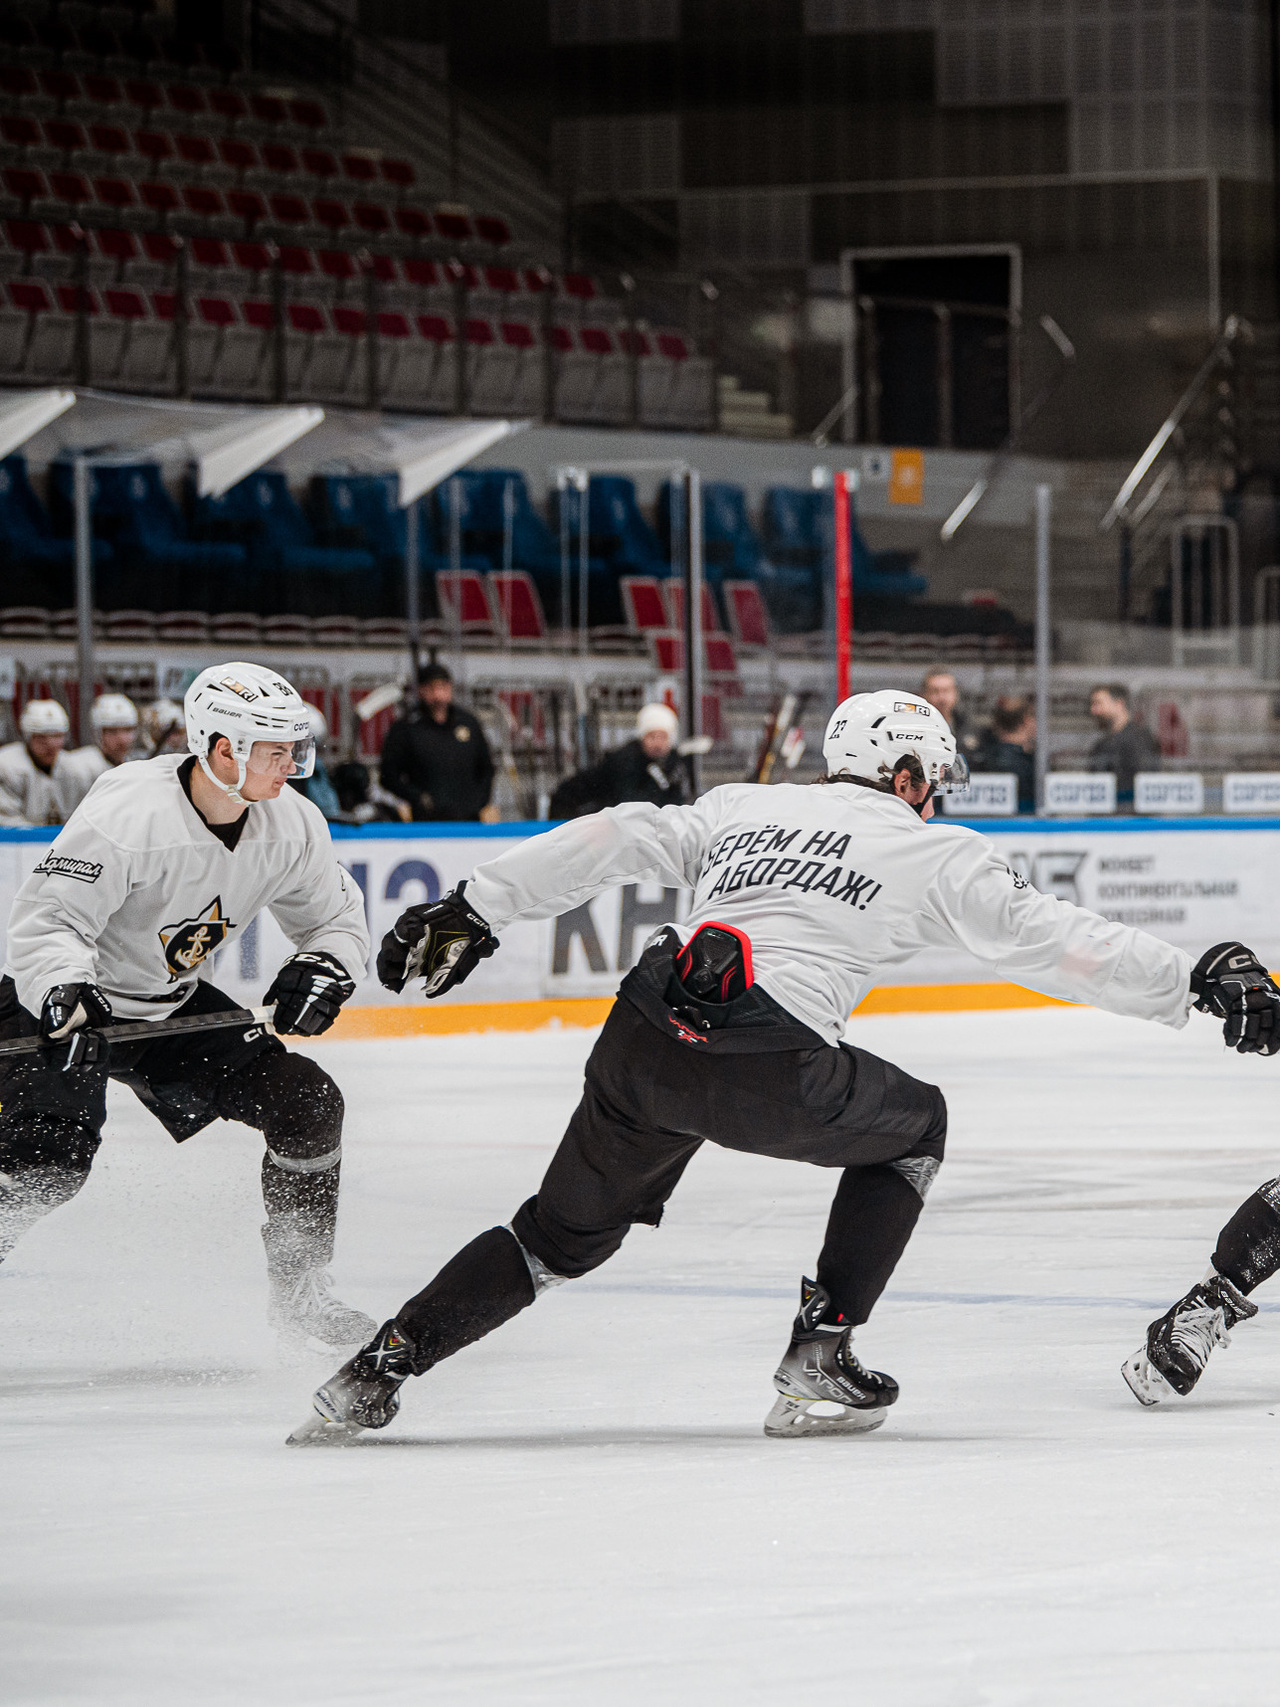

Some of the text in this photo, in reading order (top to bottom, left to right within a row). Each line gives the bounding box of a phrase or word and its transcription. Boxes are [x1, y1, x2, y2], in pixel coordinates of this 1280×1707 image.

[895, 733, 924, 742] CCM
[702, 825, 852, 878] БЕРЁМ НА
[708, 858, 883, 911] АБОРДАЖ!
